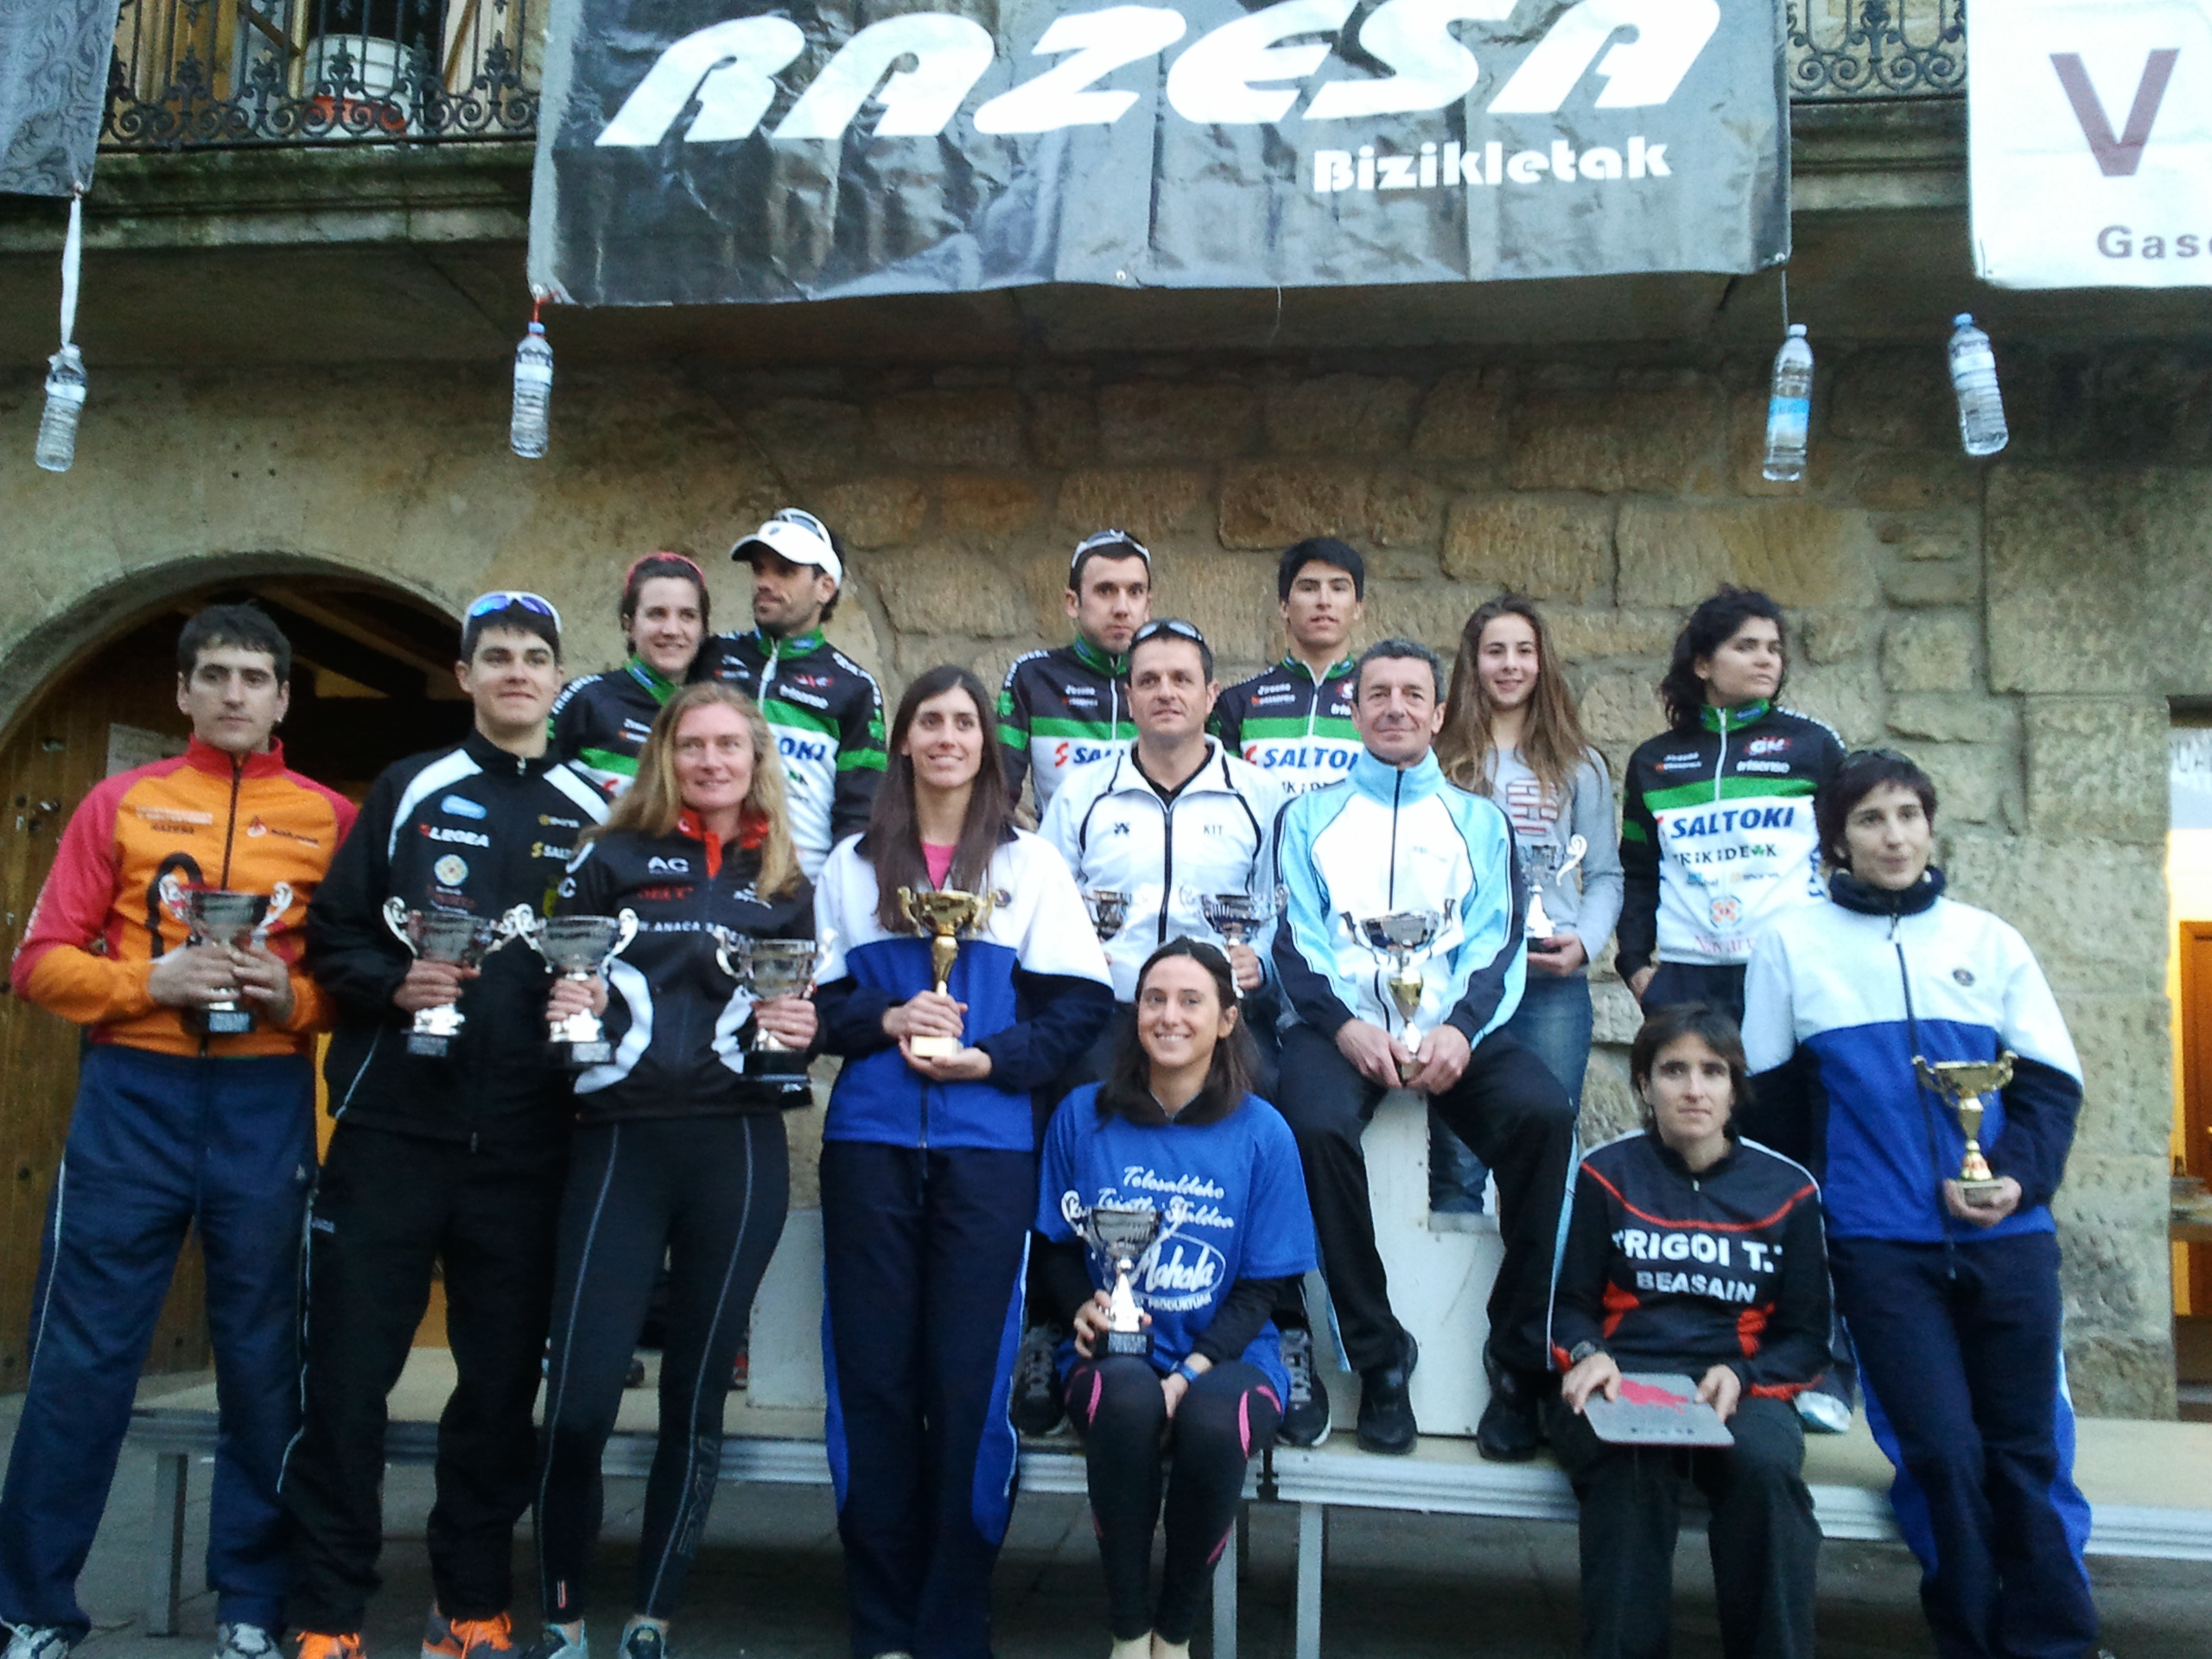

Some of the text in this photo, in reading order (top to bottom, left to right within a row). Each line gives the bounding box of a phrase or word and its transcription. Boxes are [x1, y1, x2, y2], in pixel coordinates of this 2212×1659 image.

[594, 0, 1720, 146] RAZESA
[1313, 136, 1672, 194] Bizikletak
[2096, 224, 2212, 259] Gas
[1670, 806, 1795, 839] SALTOKI
[1636, 1270, 1757, 1304] BEASAIN
